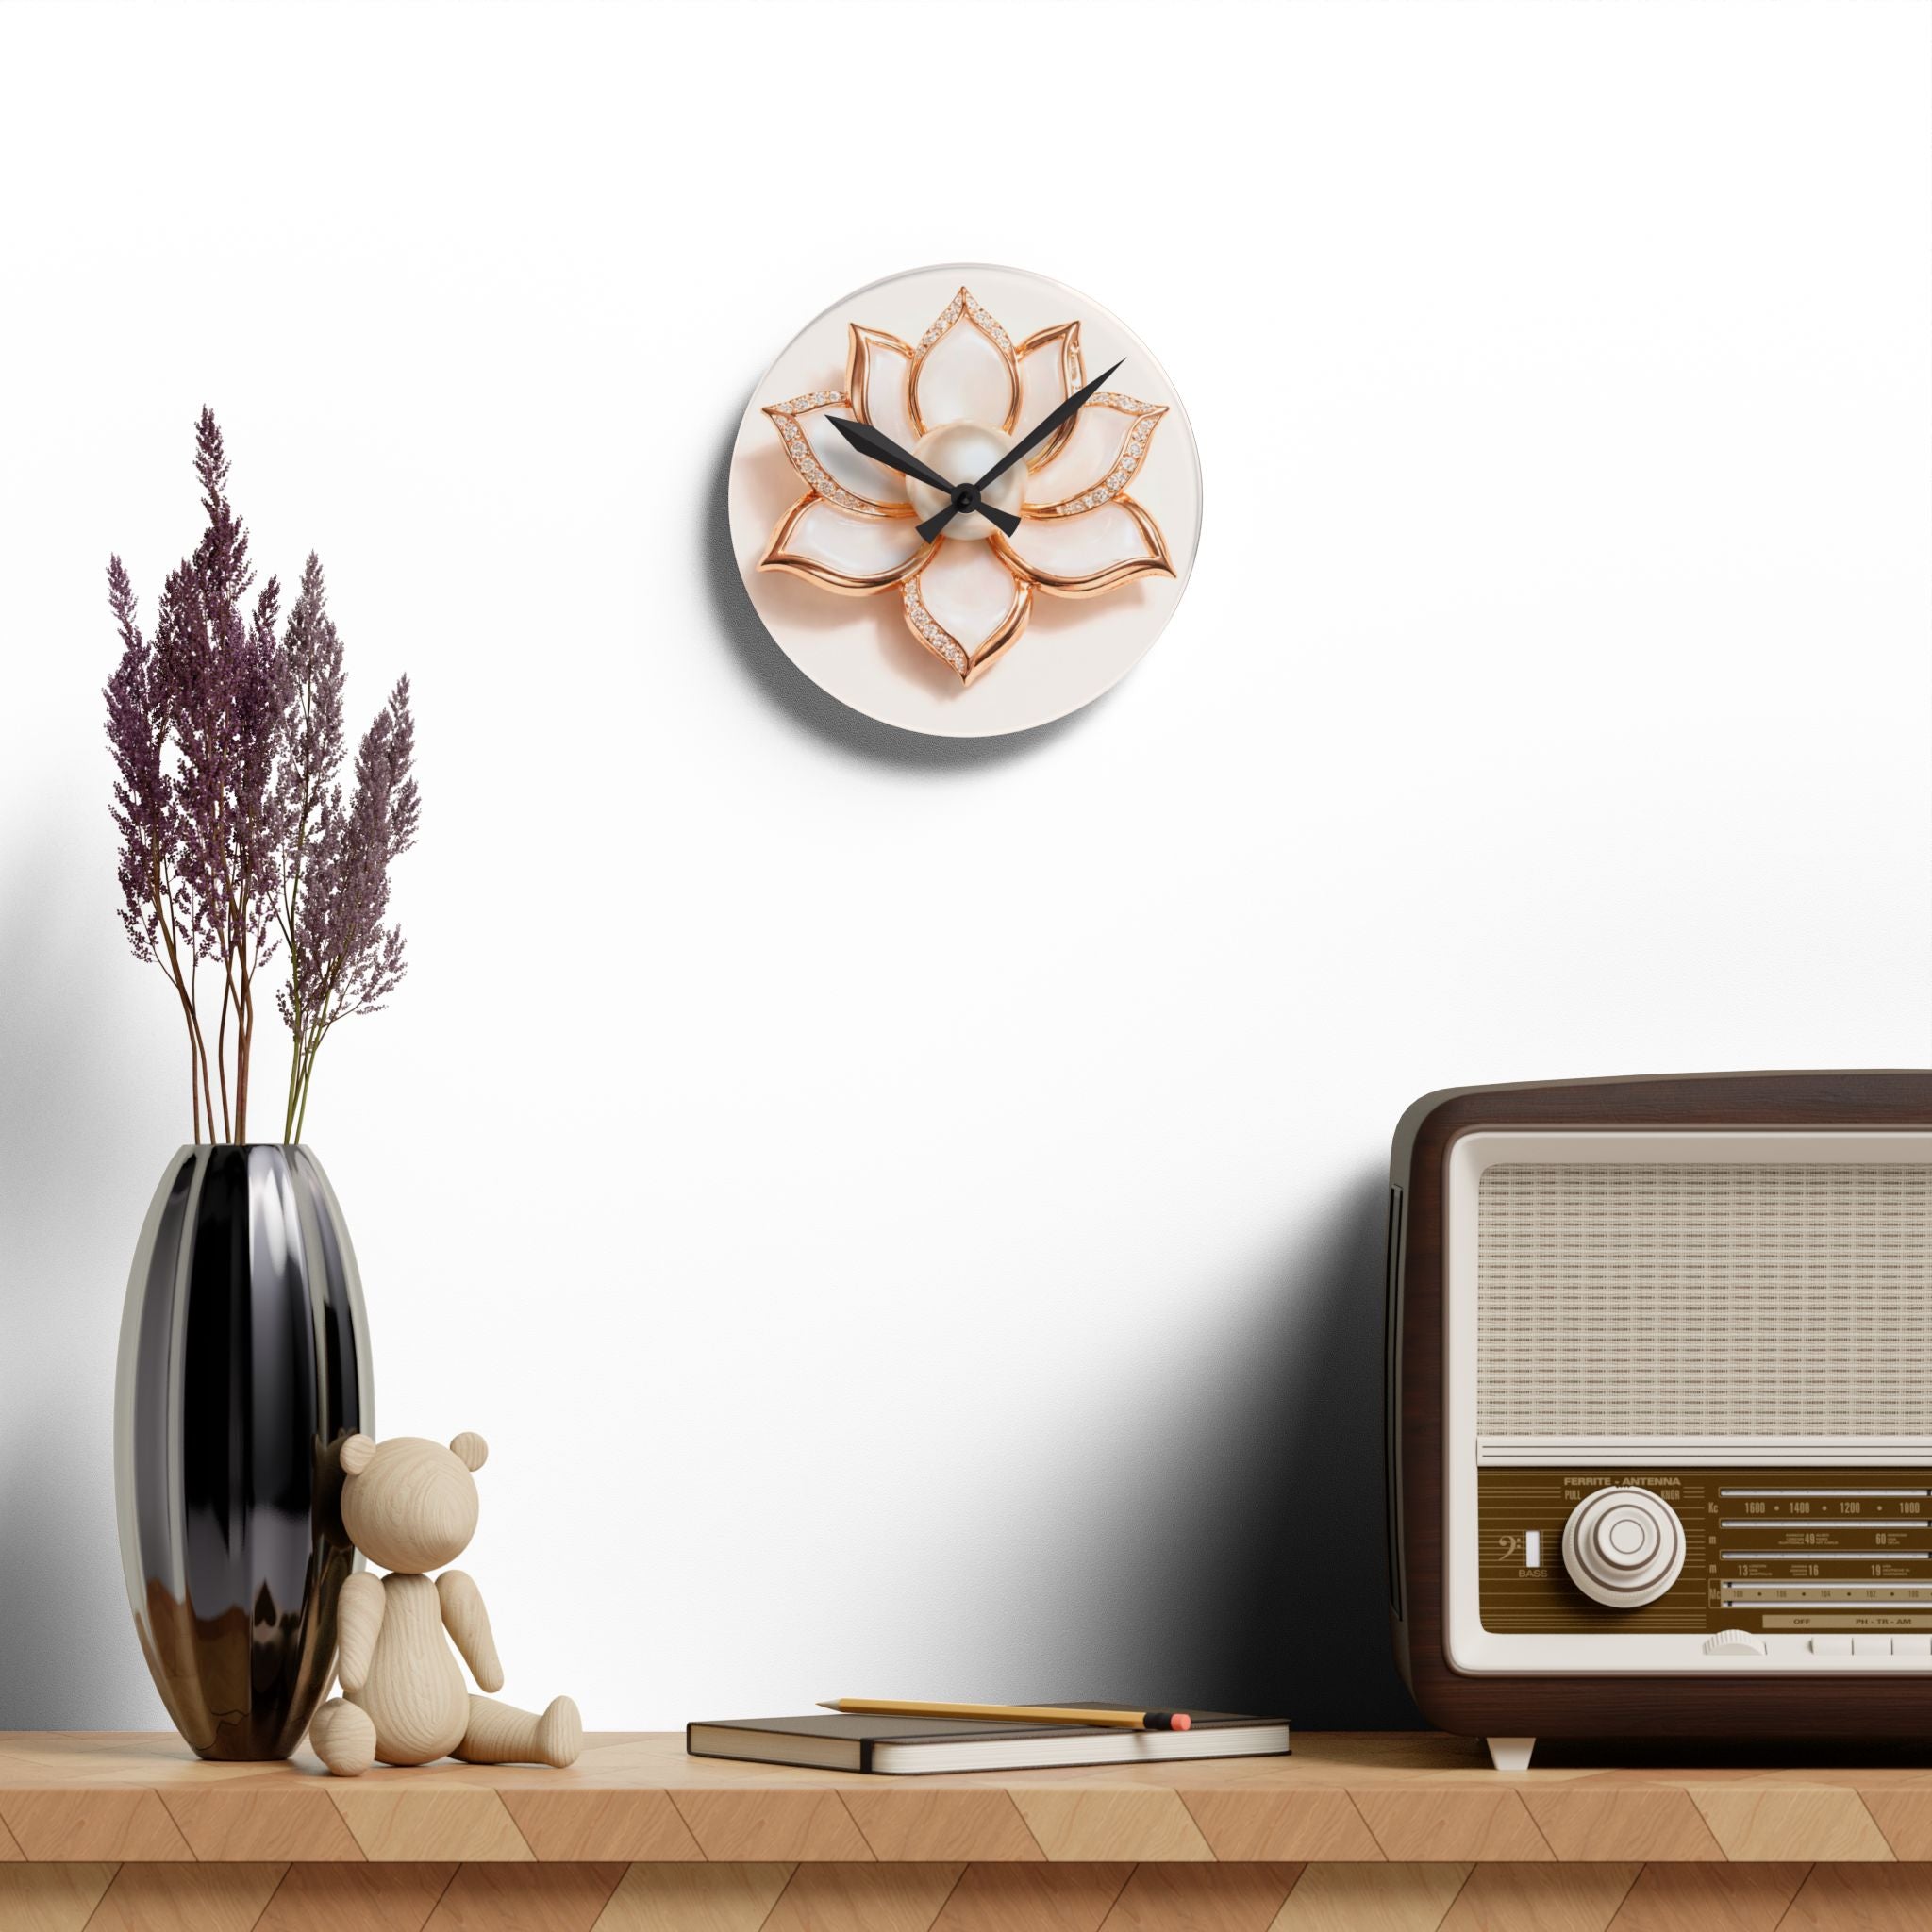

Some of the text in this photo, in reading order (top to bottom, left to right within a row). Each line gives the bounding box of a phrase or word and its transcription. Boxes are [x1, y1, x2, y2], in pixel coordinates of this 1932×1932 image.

[1564, 1477, 1611, 1486] FERRITE
[1623, 1477, 1681, 1486] ANTENNA
[1565, 1490, 1581, 1500] PULL
[1745, 1502, 1765, 1514] 1600
[1790, 1502, 1810, 1514] 1400
[1840, 1502, 1860, 1514] 1200
[1899, 1502, 1920, 1514] 1000
[1875, 1533, 1887, 1545] 60
[1518, 1570, 1548, 1578] BASS
[1738, 1564, 1749, 1576] 13
[1808, 1564, 1819, 1576] 16
